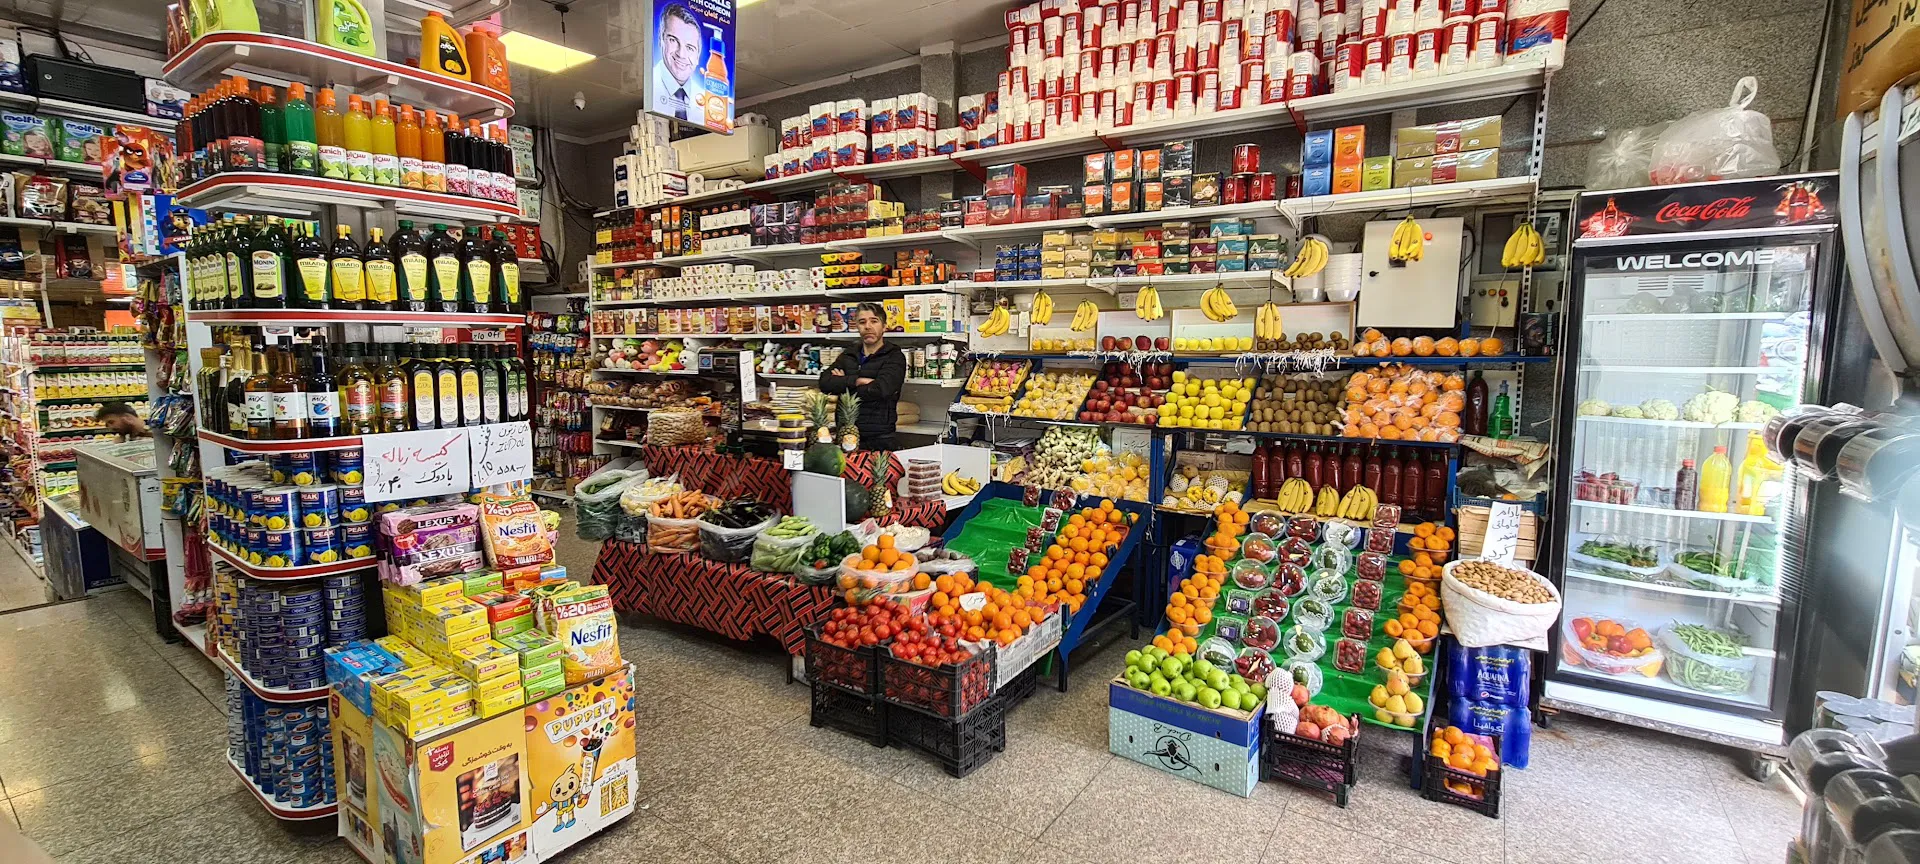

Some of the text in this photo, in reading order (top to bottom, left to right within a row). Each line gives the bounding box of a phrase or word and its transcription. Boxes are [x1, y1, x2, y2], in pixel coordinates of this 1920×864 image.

[704, 1, 731, 18] COMEON
[3, 114, 44, 125] molfix
[65, 122, 103, 135] molfix
[291, 143, 312, 151] Sunich
[1655, 196, 1758, 224] Coca-Cola
[253, 259, 276, 267] MONINI
[1616, 250, 1776, 271] WELCOME
[381, 433, 463, 472] کیسه زباله
[1496, 505, 1520, 520] بادام
[347, 525, 368, 534] PEAK
[417, 516, 455, 529] LEXUS
[499, 522, 537, 537] Nesfit
[419, 545, 465, 563] LEXUS
[556, 602, 588, 619] %20
[571, 623, 613, 646] Nesfit
[1476, 668, 1510, 684] AQUAFINA
[551, 701, 612, 736] PUPPET
